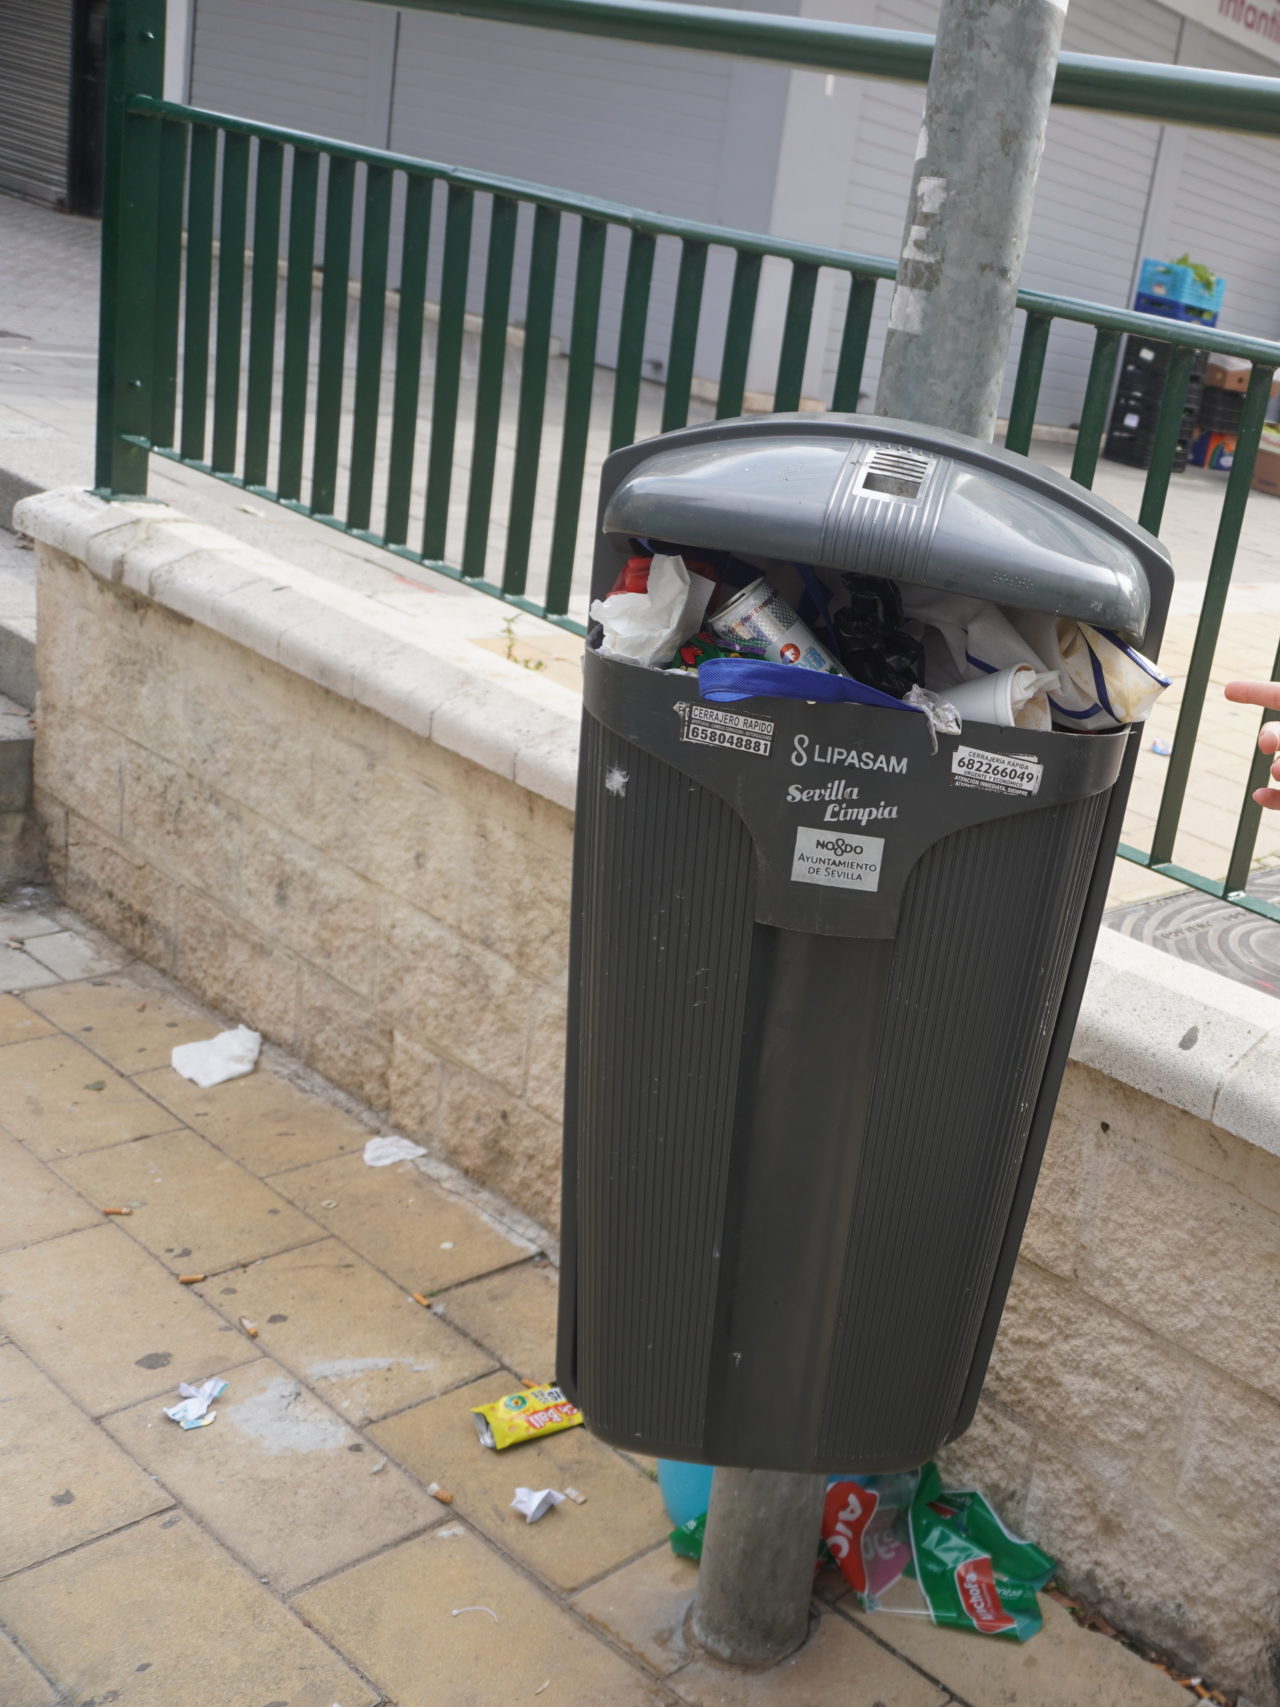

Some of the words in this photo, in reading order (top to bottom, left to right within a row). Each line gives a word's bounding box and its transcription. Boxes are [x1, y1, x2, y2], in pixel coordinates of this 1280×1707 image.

[693, 707, 740, 726] CERRAJERO
[742, 718, 773, 734] RAPIDO
[691, 726, 769, 754] 658048881
[813, 744, 908, 774] LIPASAM
[957, 757, 1034, 783] 682266049
[786, 779, 860, 803] Sevilla
[823, 800, 899, 826] Limpia
[797, 853, 877, 873] AYUNTAMIENTO
[807, 866, 821, 876] DE
[824, 867, 863, 881] SEVILLA
